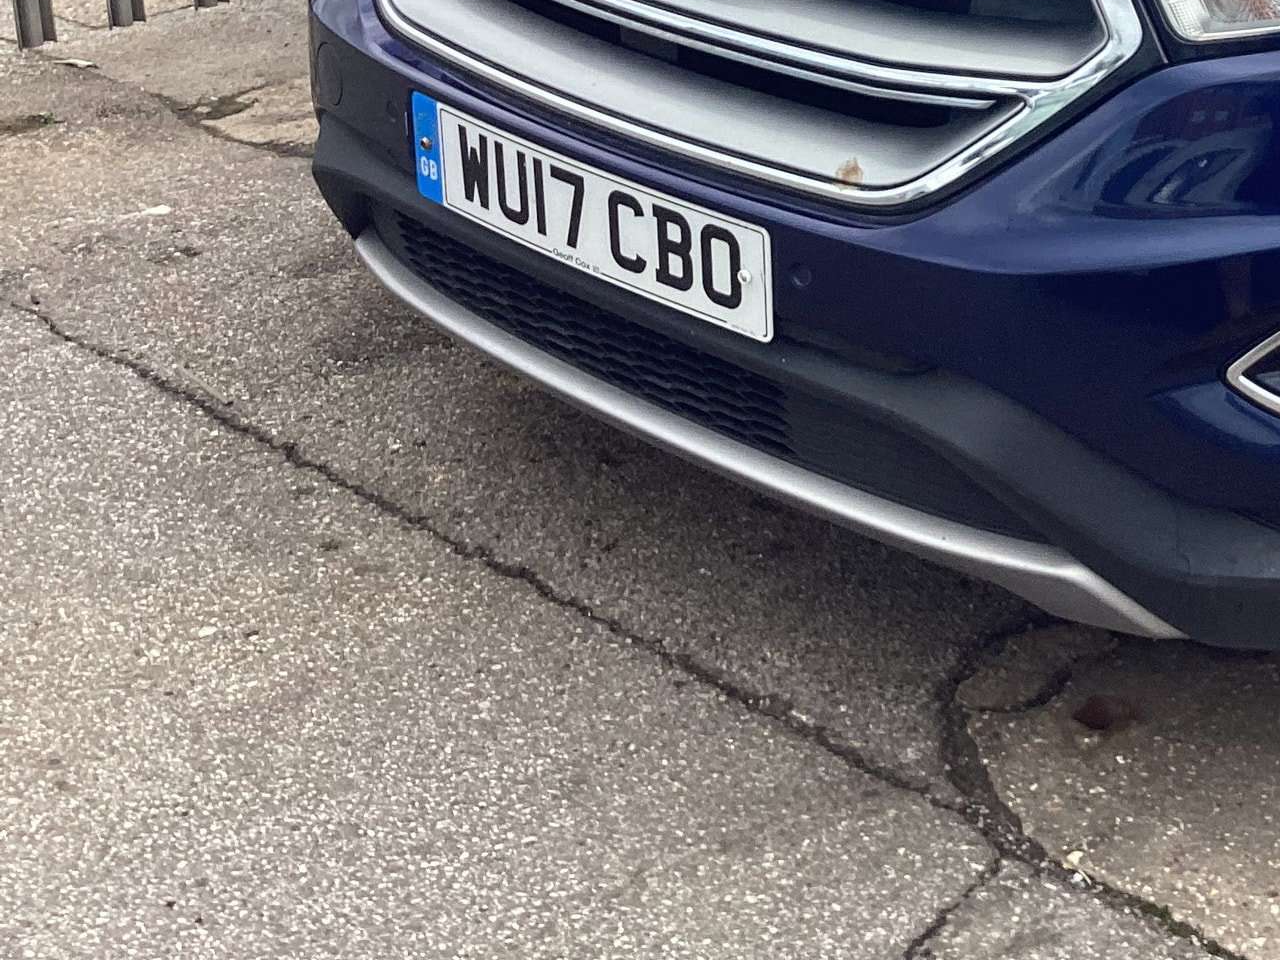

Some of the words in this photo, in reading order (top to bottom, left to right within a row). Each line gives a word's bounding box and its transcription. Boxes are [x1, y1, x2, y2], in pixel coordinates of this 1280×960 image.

[420, 156, 438, 181] GB
[457, 124, 585, 249] WU17
[607, 189, 742, 310] CBO
